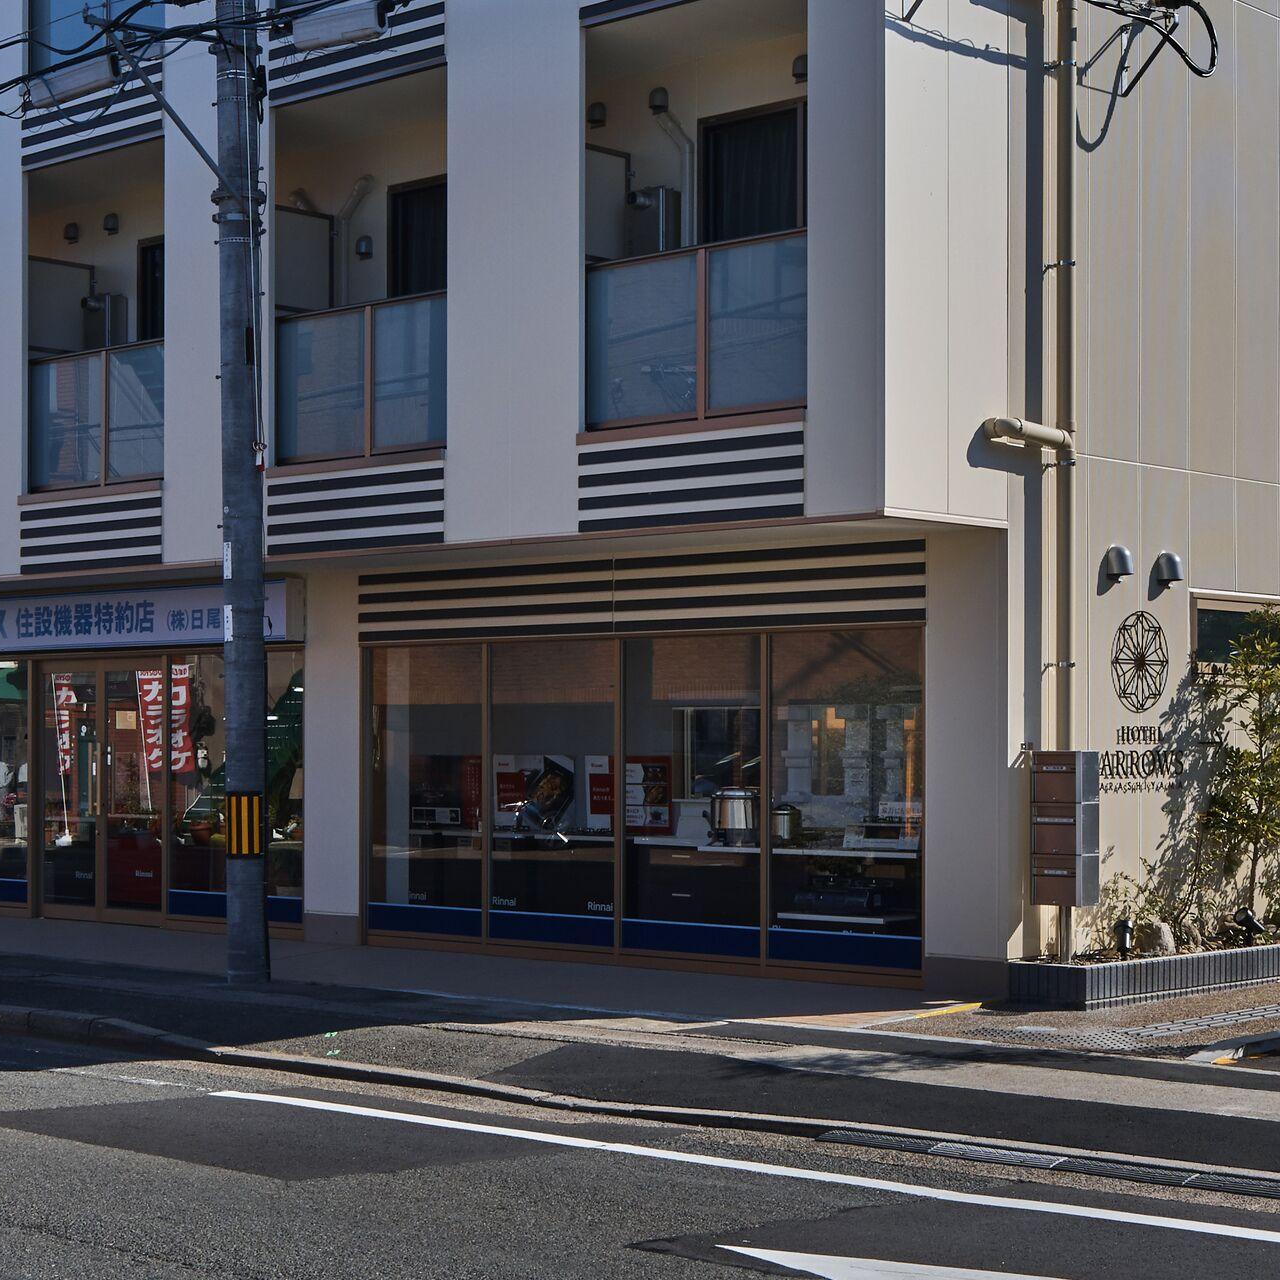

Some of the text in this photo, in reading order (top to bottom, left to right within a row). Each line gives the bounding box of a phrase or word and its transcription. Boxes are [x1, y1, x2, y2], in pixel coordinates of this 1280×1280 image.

[16, 600, 155, 639] 住設機器特約店
[1121, 725, 1163, 742] HOTEL
[1099, 749, 1184, 778] ARROWS
[1099, 781, 1184, 791] ARASHIYAMA
[409, 891, 427, 902] innai
[492, 895, 517, 907] Rinnai
[587, 900, 614, 913] Rinnai
